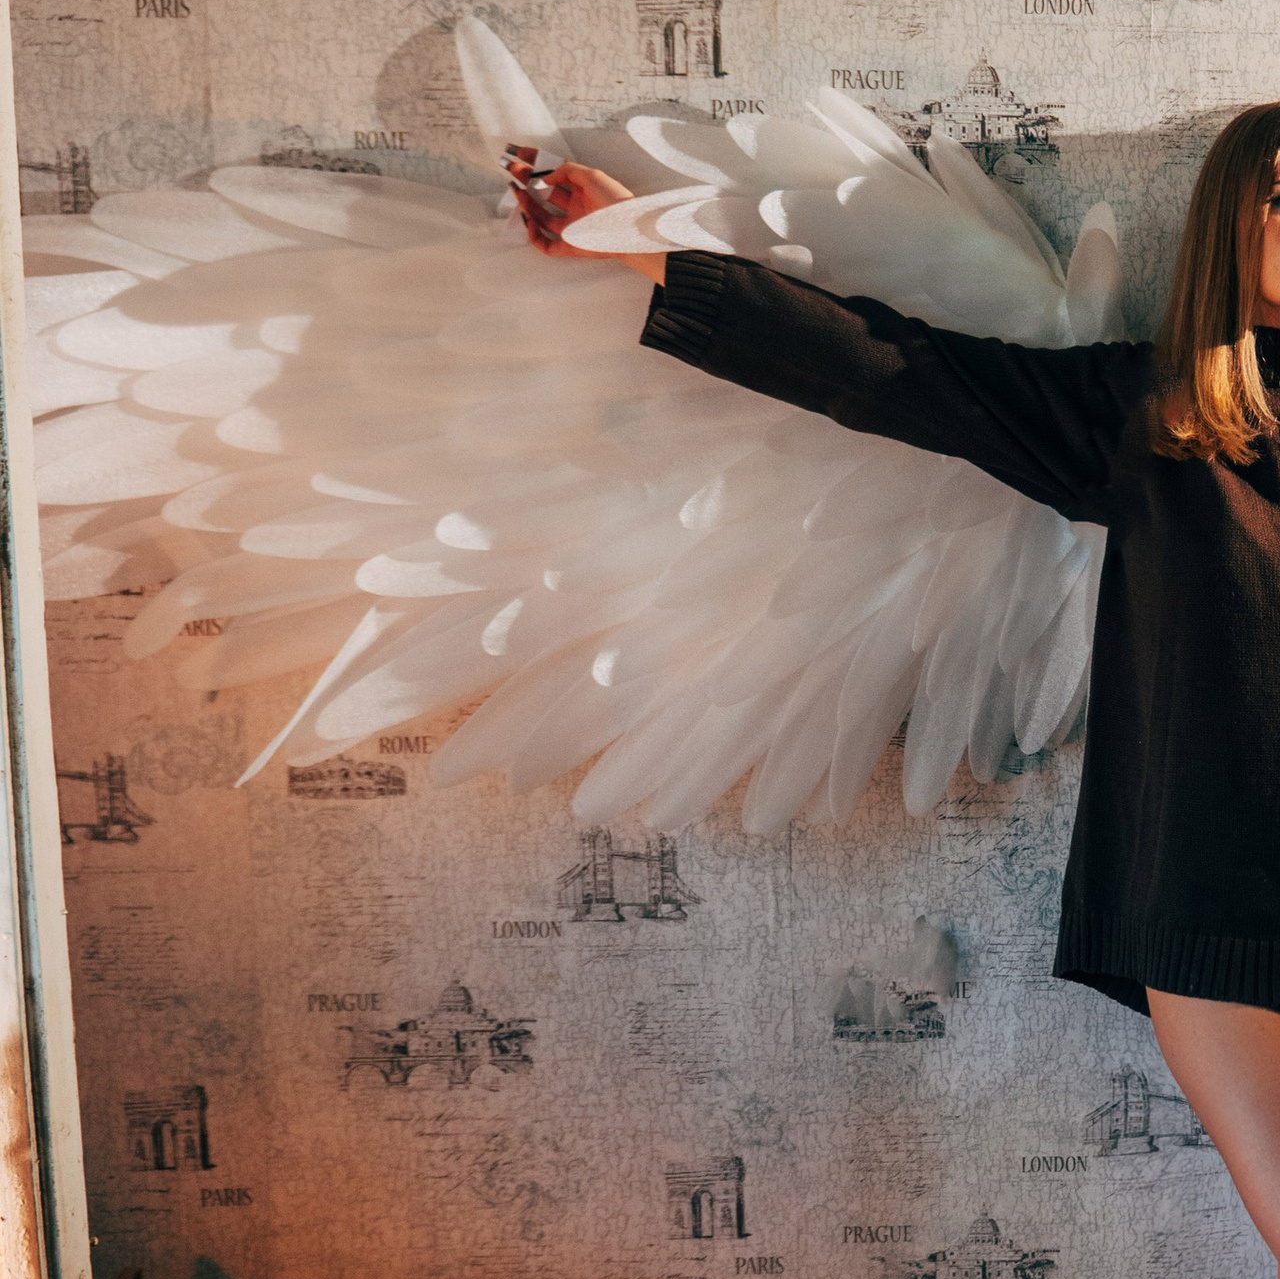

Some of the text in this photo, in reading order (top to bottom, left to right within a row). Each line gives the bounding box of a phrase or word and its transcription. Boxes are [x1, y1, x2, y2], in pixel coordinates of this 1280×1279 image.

[830, 68, 905, 91] PRAGUE
[353, 130, 411, 152] ROME
[379, 734, 434, 756] ROME
[492, 920, 563, 940] LONDON
[307, 993, 383, 1014] PRAGUE
[1020, 1155, 1088, 1175] LONDON
[201, 1188, 254, 1209] PARIS
[842, 1224, 913, 1245] PRAGUE
[734, 1255, 785, 1276] PARIS
